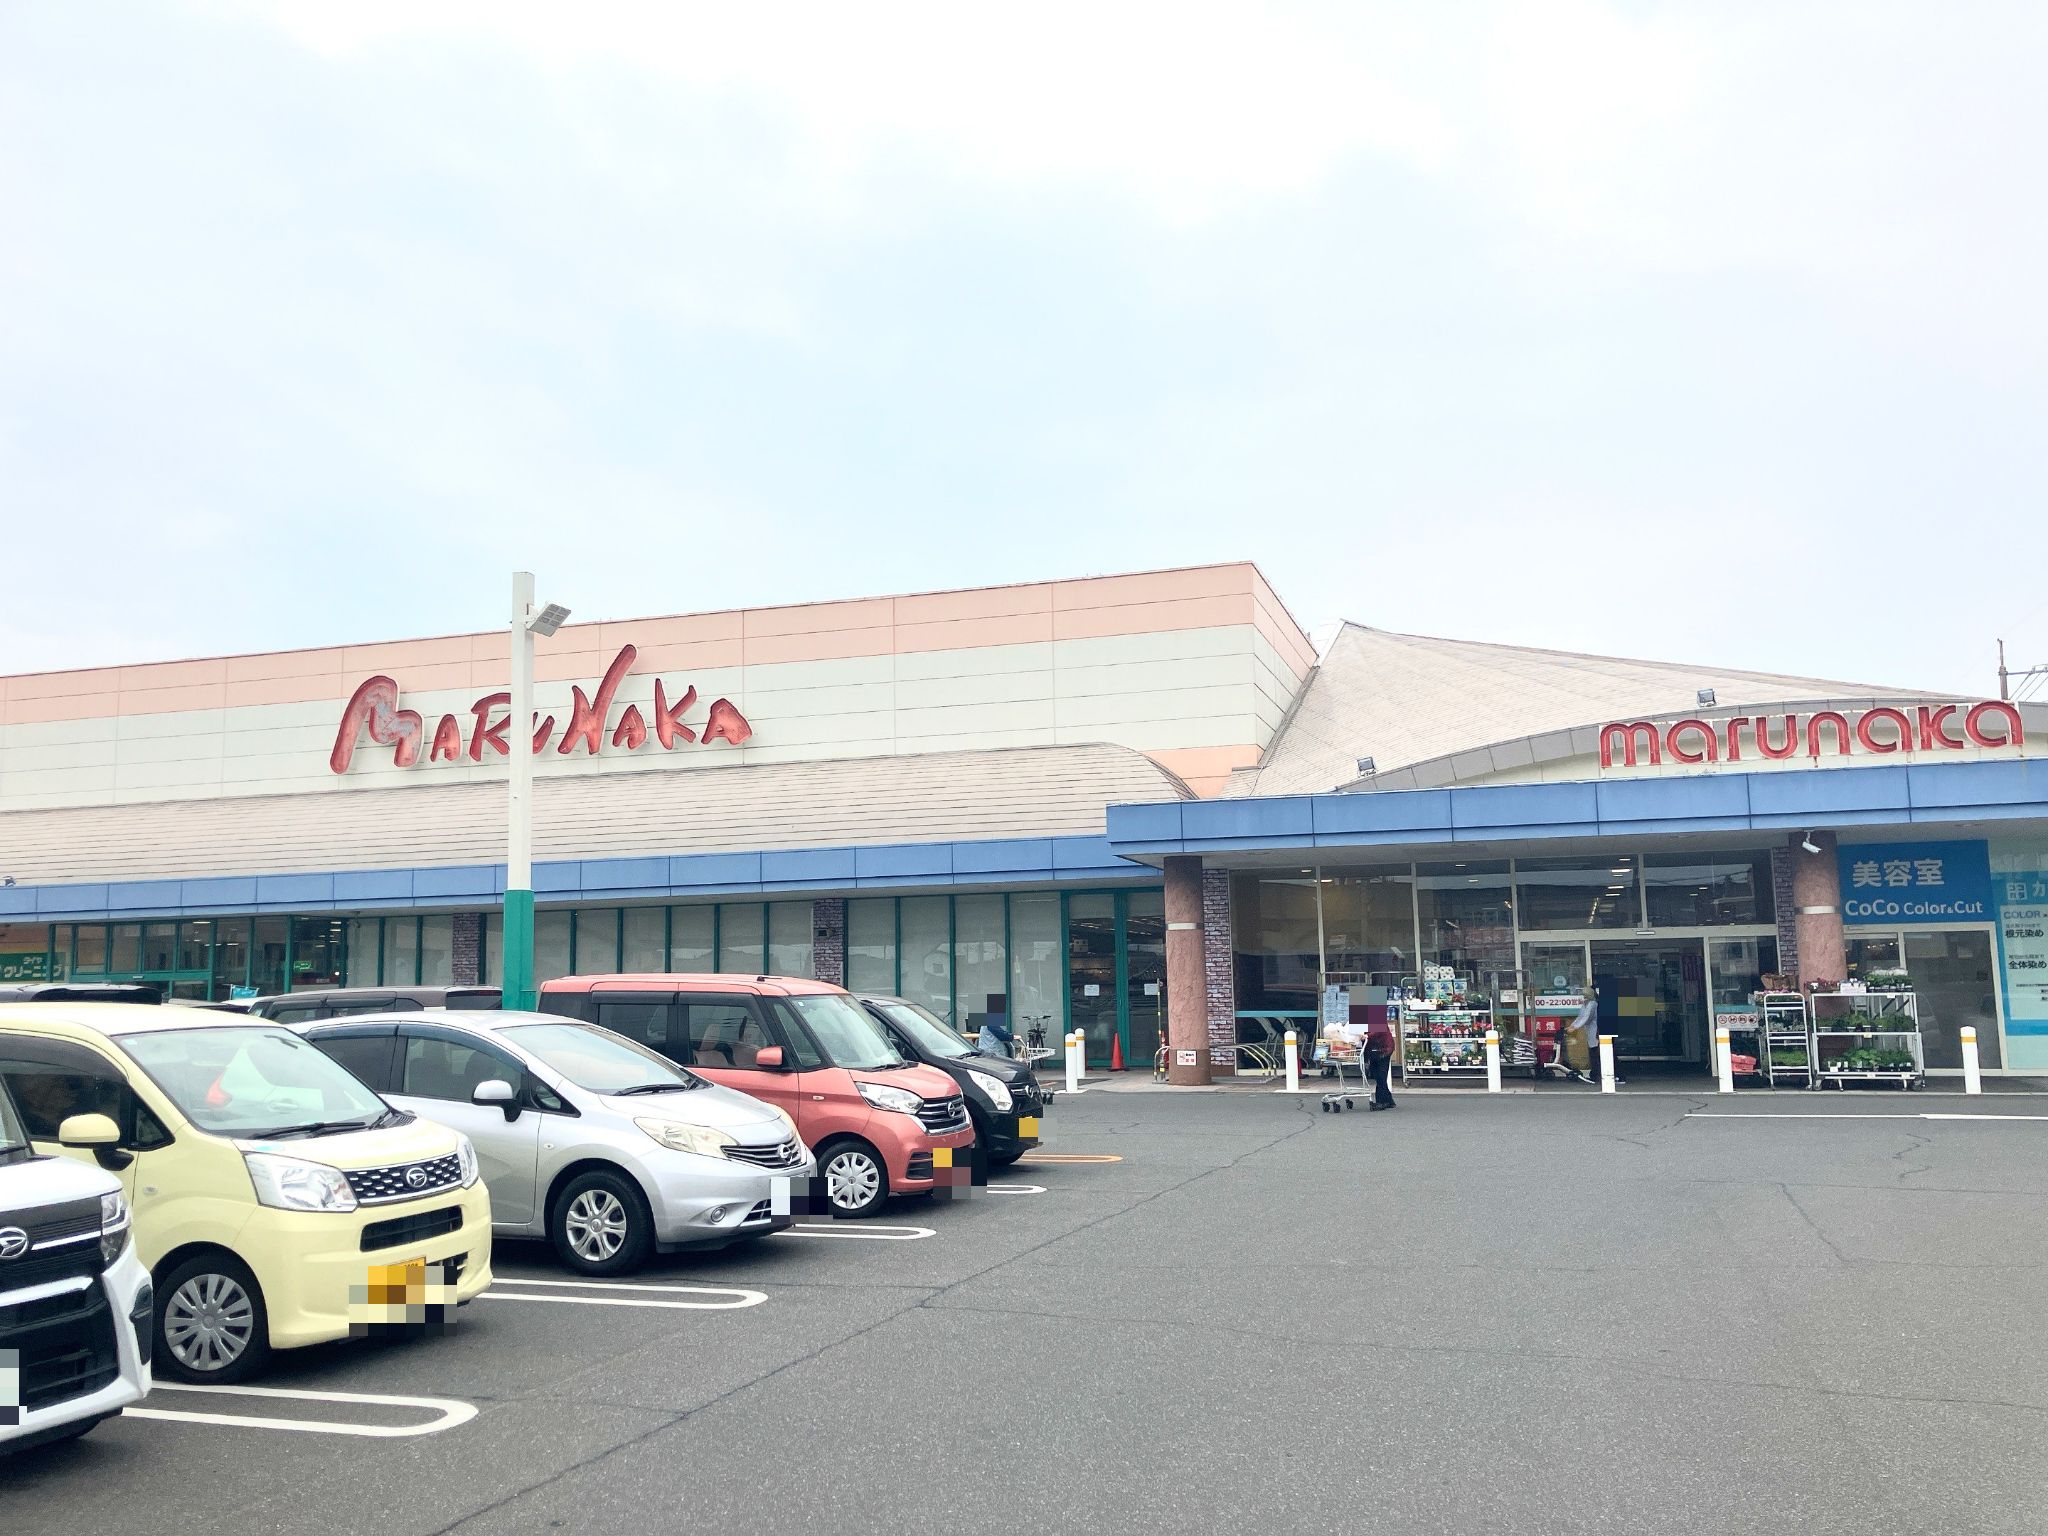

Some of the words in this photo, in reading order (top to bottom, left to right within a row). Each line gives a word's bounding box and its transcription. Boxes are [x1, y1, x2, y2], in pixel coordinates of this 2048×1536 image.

[1600, 700, 2025, 768] marunaka
[1852, 859, 1945, 888] 美容室
[1845, 899, 1900, 917] CoCo
[2003, 910, 2041, 919] COLOR
[2005, 929, 2044, 939] 根元染め
[2008, 960, 2047, 970] 全体染め
